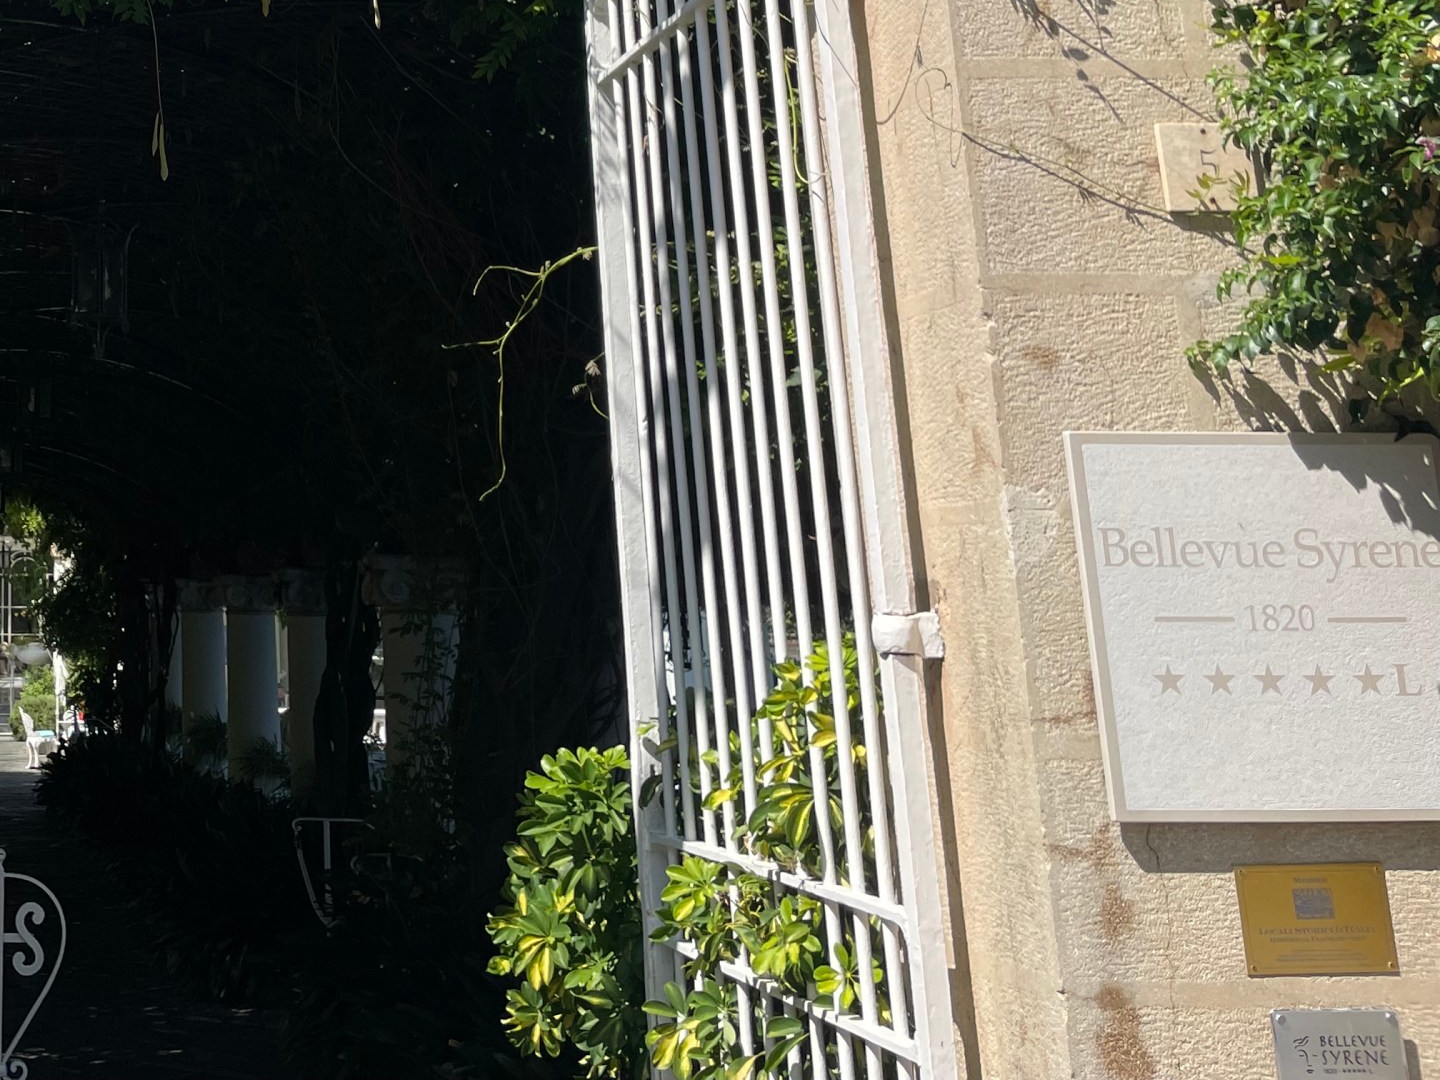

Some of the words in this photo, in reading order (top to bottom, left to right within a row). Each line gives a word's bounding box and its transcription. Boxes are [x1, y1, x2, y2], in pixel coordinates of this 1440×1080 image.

[1097, 526, 1286, 569] Bellevue
[1293, 528, 1440, 583] Syrene
[1244, 604, 1316, 632] 1820
[1320, 1035, 1387, 1047] BELLEVUE
[1322, 1050, 1390, 1065] SYRENE
